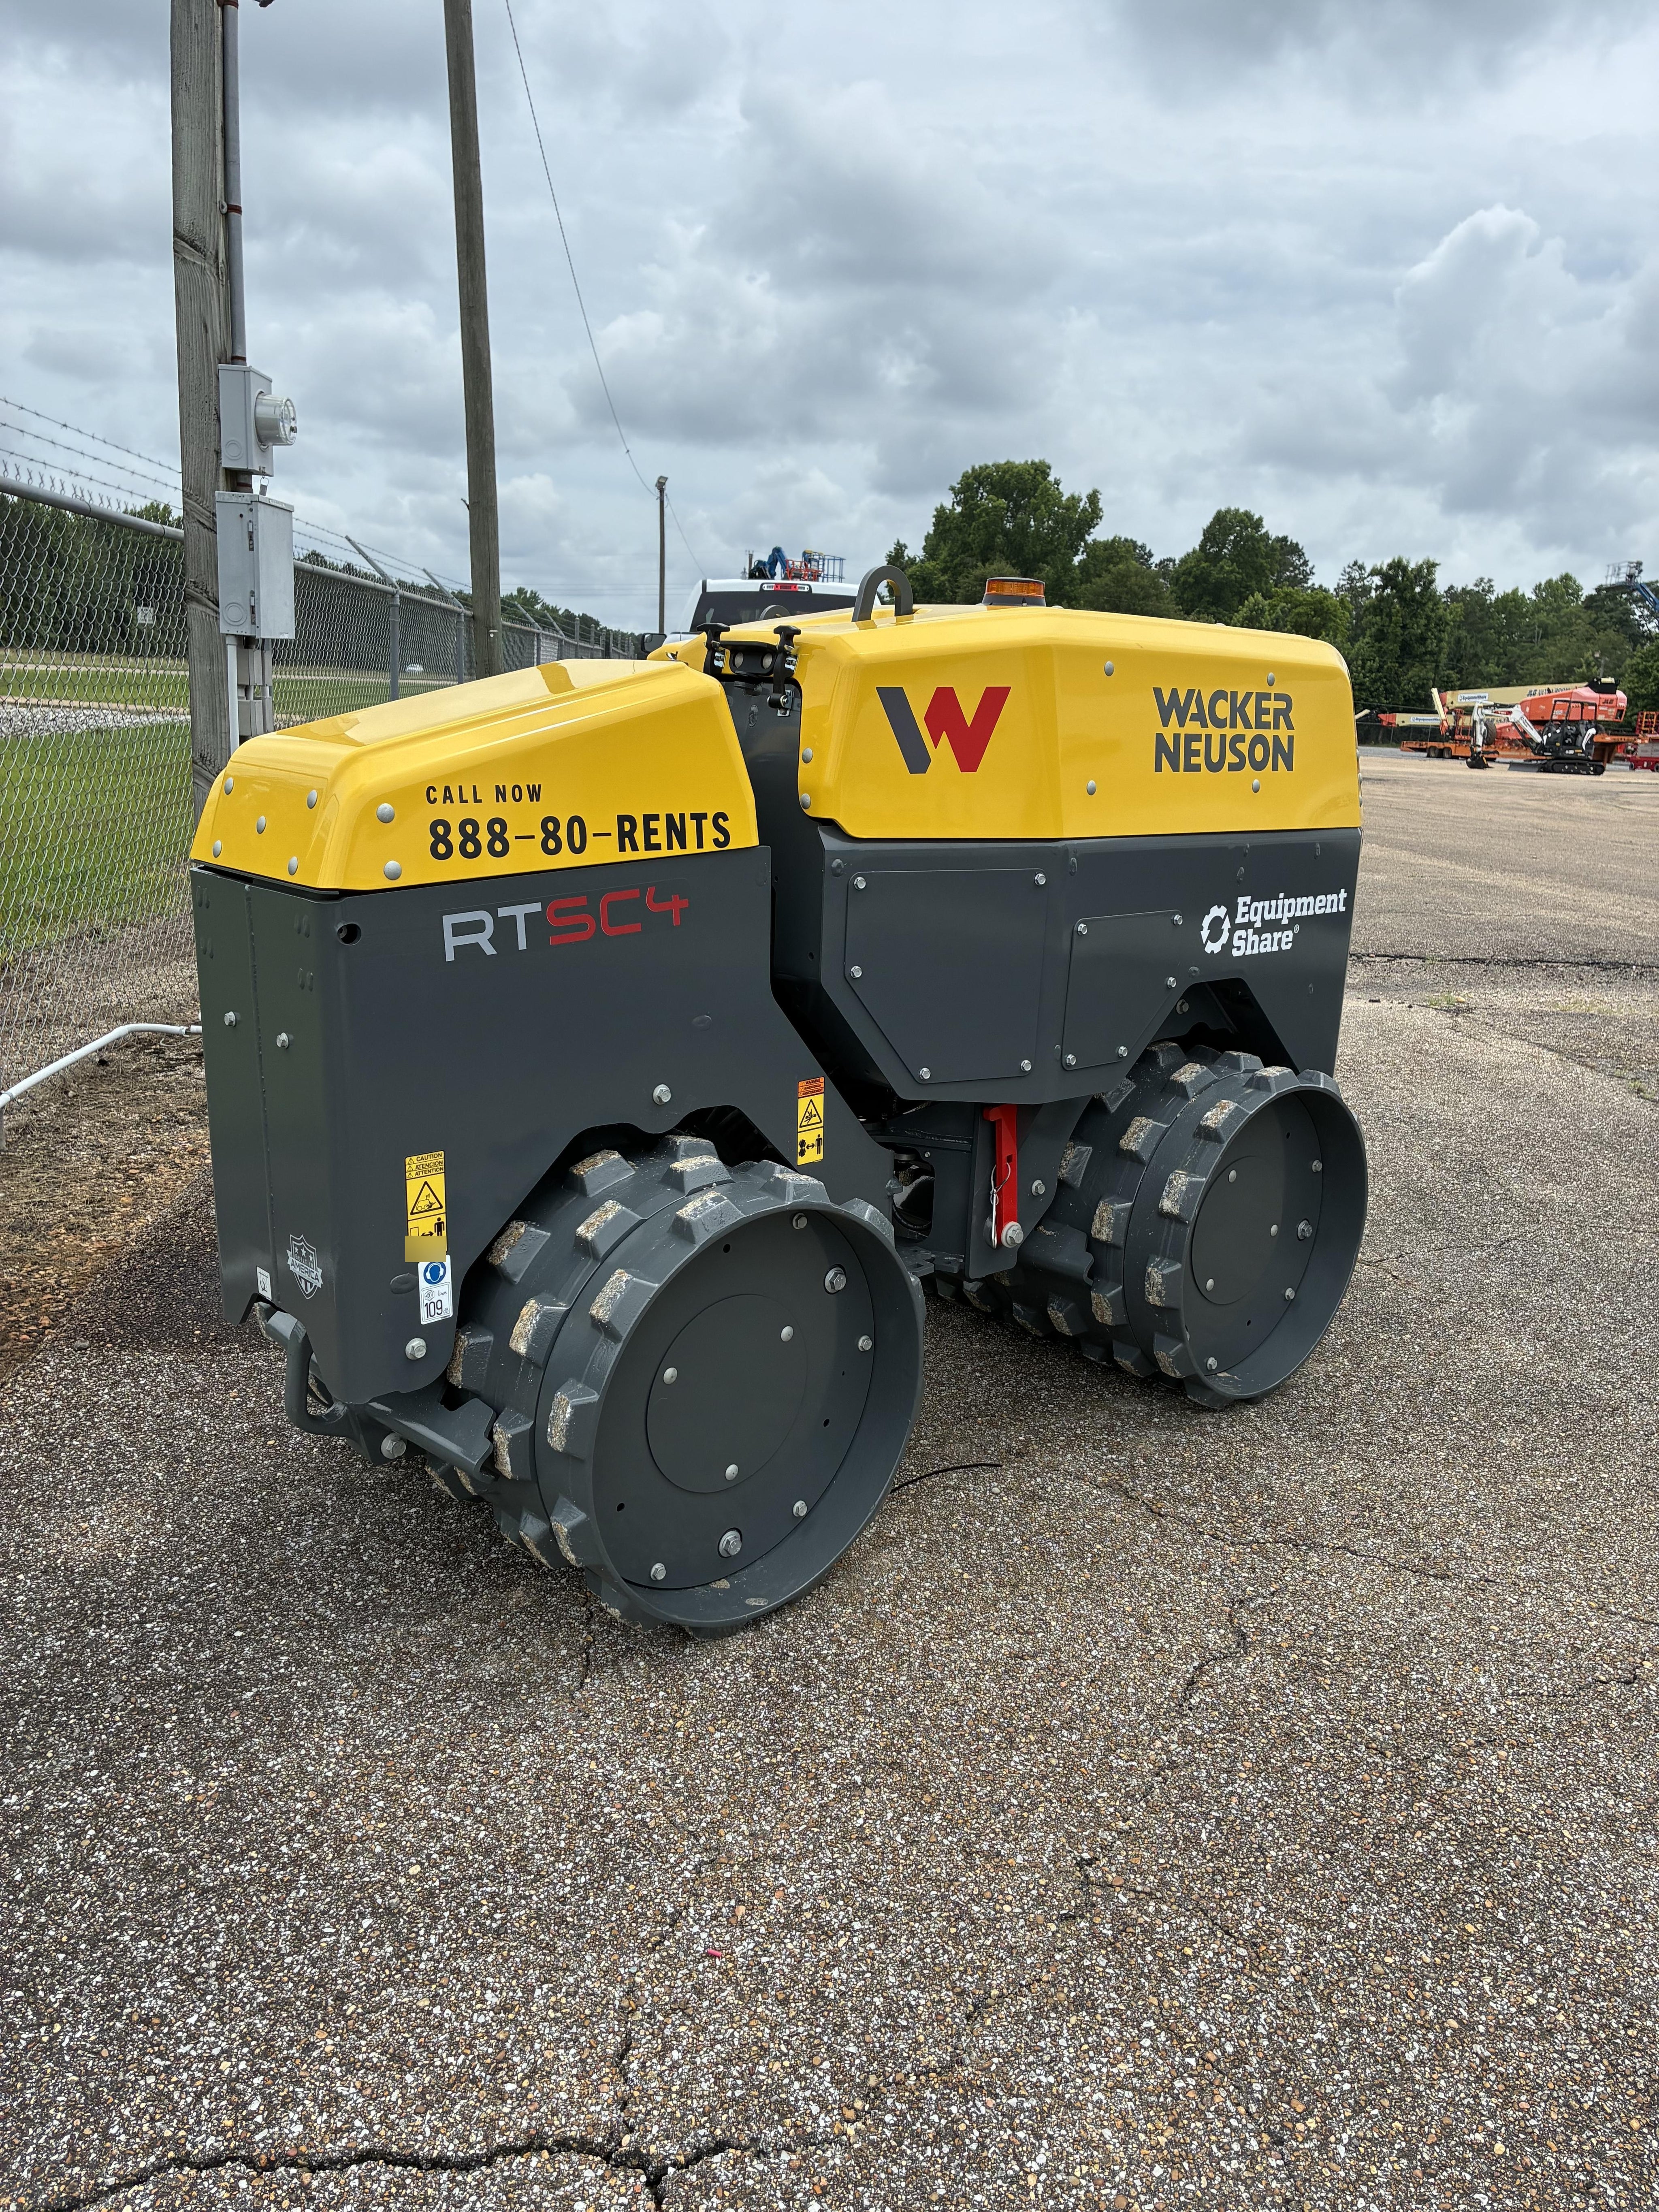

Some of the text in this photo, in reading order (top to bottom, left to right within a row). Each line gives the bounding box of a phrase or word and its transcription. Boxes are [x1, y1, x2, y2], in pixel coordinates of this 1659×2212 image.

[1153, 687, 1295, 730] WACKER
[1154, 733, 1294, 773] NEUSON
[426, 783, 542, 804] CALL NOW
[429, 811, 730, 861] 888-80-RENTS
[1235, 888, 1348, 928] Equipment
[442, 886, 689, 962] RTSC4
[416, 1152, 442, 1162] CAUTION
[415, 1167, 444, 1176] ATTENTION
[291, 1258, 320, 1284] AMERICA
[295, 1253, 307, 1265] BUILT
[424, 1299, 443, 1319] 109
